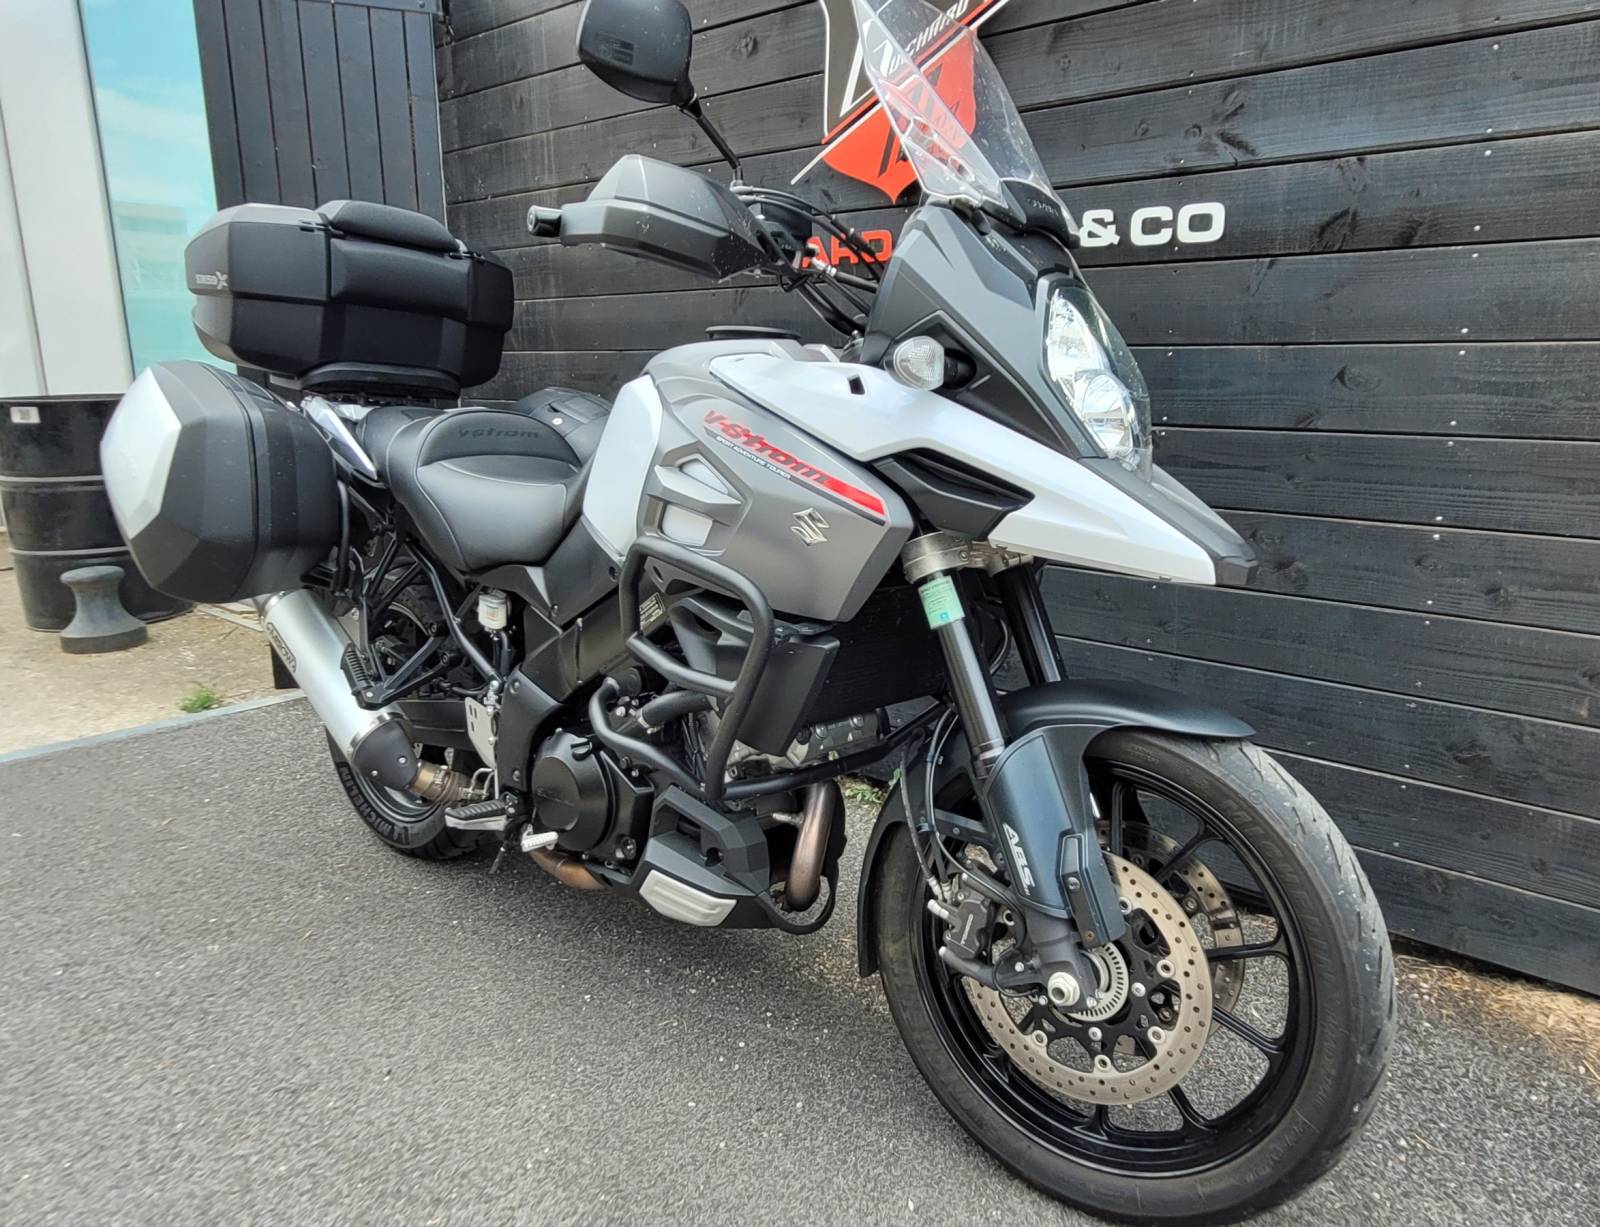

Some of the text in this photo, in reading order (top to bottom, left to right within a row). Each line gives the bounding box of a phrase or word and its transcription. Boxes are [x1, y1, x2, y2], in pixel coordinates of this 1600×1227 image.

[1079, 208, 1121, 248] &
[1130, 202, 1226, 246] CO
[765, 462, 792, 480] TOURER
[1002, 822, 1036, 888] ABS
